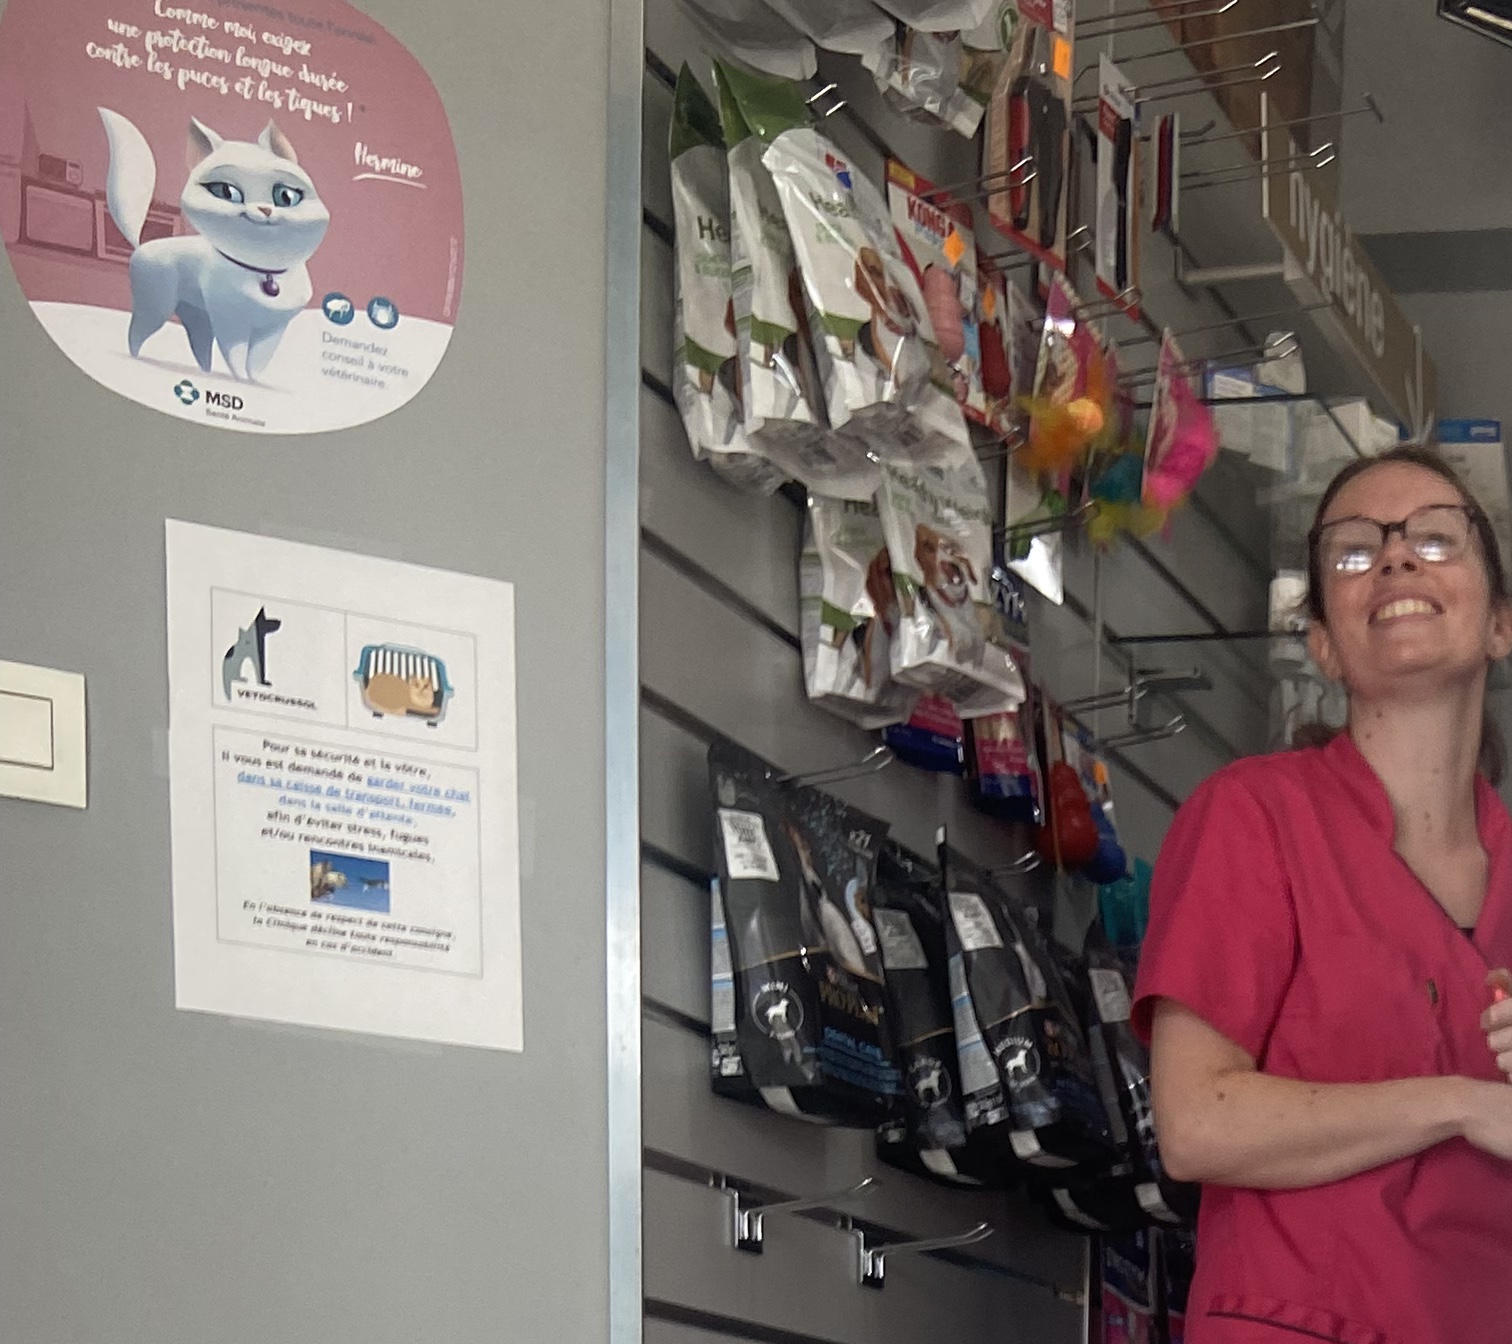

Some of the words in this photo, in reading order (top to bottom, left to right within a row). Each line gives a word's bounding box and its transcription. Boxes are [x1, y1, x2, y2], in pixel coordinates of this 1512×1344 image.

[154, 0, 219, 30] Comme
[262, 31, 312, 56] exigez
[107, 18, 142, 38] une
[145, 29, 232, 64] protection
[235, 46, 294, 78] longue
[298, 64, 349, 93] durée
[86, 42, 142, 69] contre
[147, 52, 174, 80] les
[177, 67, 229, 94] puces
[235, 76, 255, 99] et
[258, 79, 282, 108] les
[285, 87, 343, 123] tiques
[354, 142, 423, 179] Hermine
[322, 330, 388, 356] Demandez
[322, 350, 364, 366] conseil
[378, 363, 409, 378] votre
[322, 366, 386, 389] vétérinaire
[205, 390, 244, 411] MSD
[234, 753, 261, 768] vous
[266, 759, 283, 771] est
[288, 762, 343, 780] demandé
[347, 772, 362, 783] de
